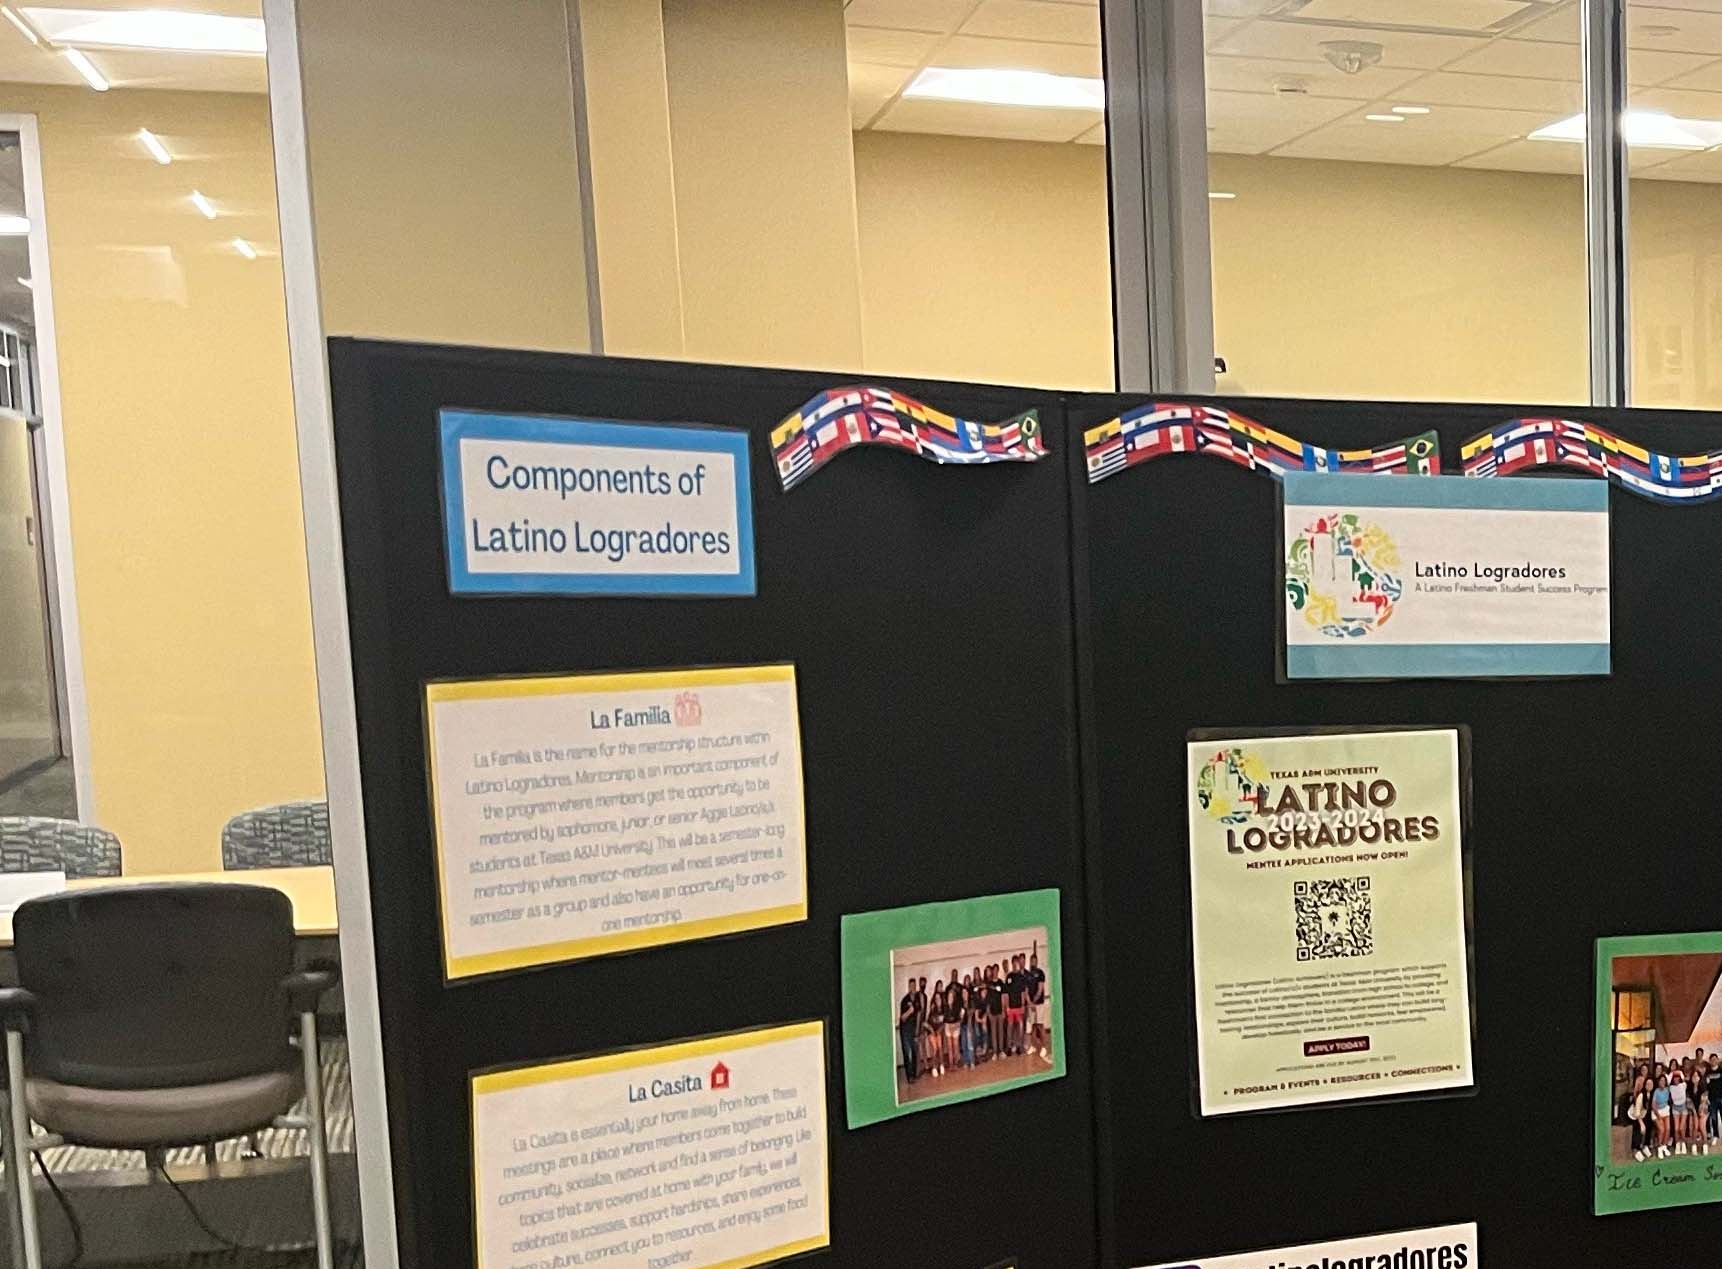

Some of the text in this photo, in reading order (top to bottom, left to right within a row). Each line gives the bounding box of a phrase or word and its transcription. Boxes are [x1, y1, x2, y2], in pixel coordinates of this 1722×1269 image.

[487, 456, 706, 500] Components of
[473, 518, 731, 562] Latino Logradores
[1415, 561, 1567, 582] Latino Logradores
[1414, 582, 1423, 593] A
[1424, 582, 1453, 594] Latino
[1454, 582, 1498, 594] Freshman
[1500, 583, 1536, 595] Student
[1537, 583, 1572, 595] Success
[590, 706, 672, 730] La Familia
[598, 741, 616, 758] for
[617, 740, 636, 756] the
[1270, 769, 1299, 780] TEXAS
[1323, 766, 1380, 777] UNIVERSITY
[1256, 779, 1397, 817] LATINO
[1268, 808, 1386, 833] 2023-2024
[1226, 815, 1440, 854] LOGRADORES
[1246, 859, 1282, 870] MENTEE
[1284, 855, 1354, 867] APPLICATIONS
[1356, 853, 1379, 863] NOW
[1307, 1043, 1335, 1055] APPLY
[628, 1072, 703, 1103] La Casita
[1232, 1083, 1278, 1096] PROGRAM
[1288, 1079, 1320, 1090] EVENTS
[1330, 1072, 1381, 1085] RESOURCES
[1390, 1064, 1454, 1079] CONNECTIONS
[1607, 1171, 1642, 1192] Ice
[1651, 1167, 1697, 1186] Cream
